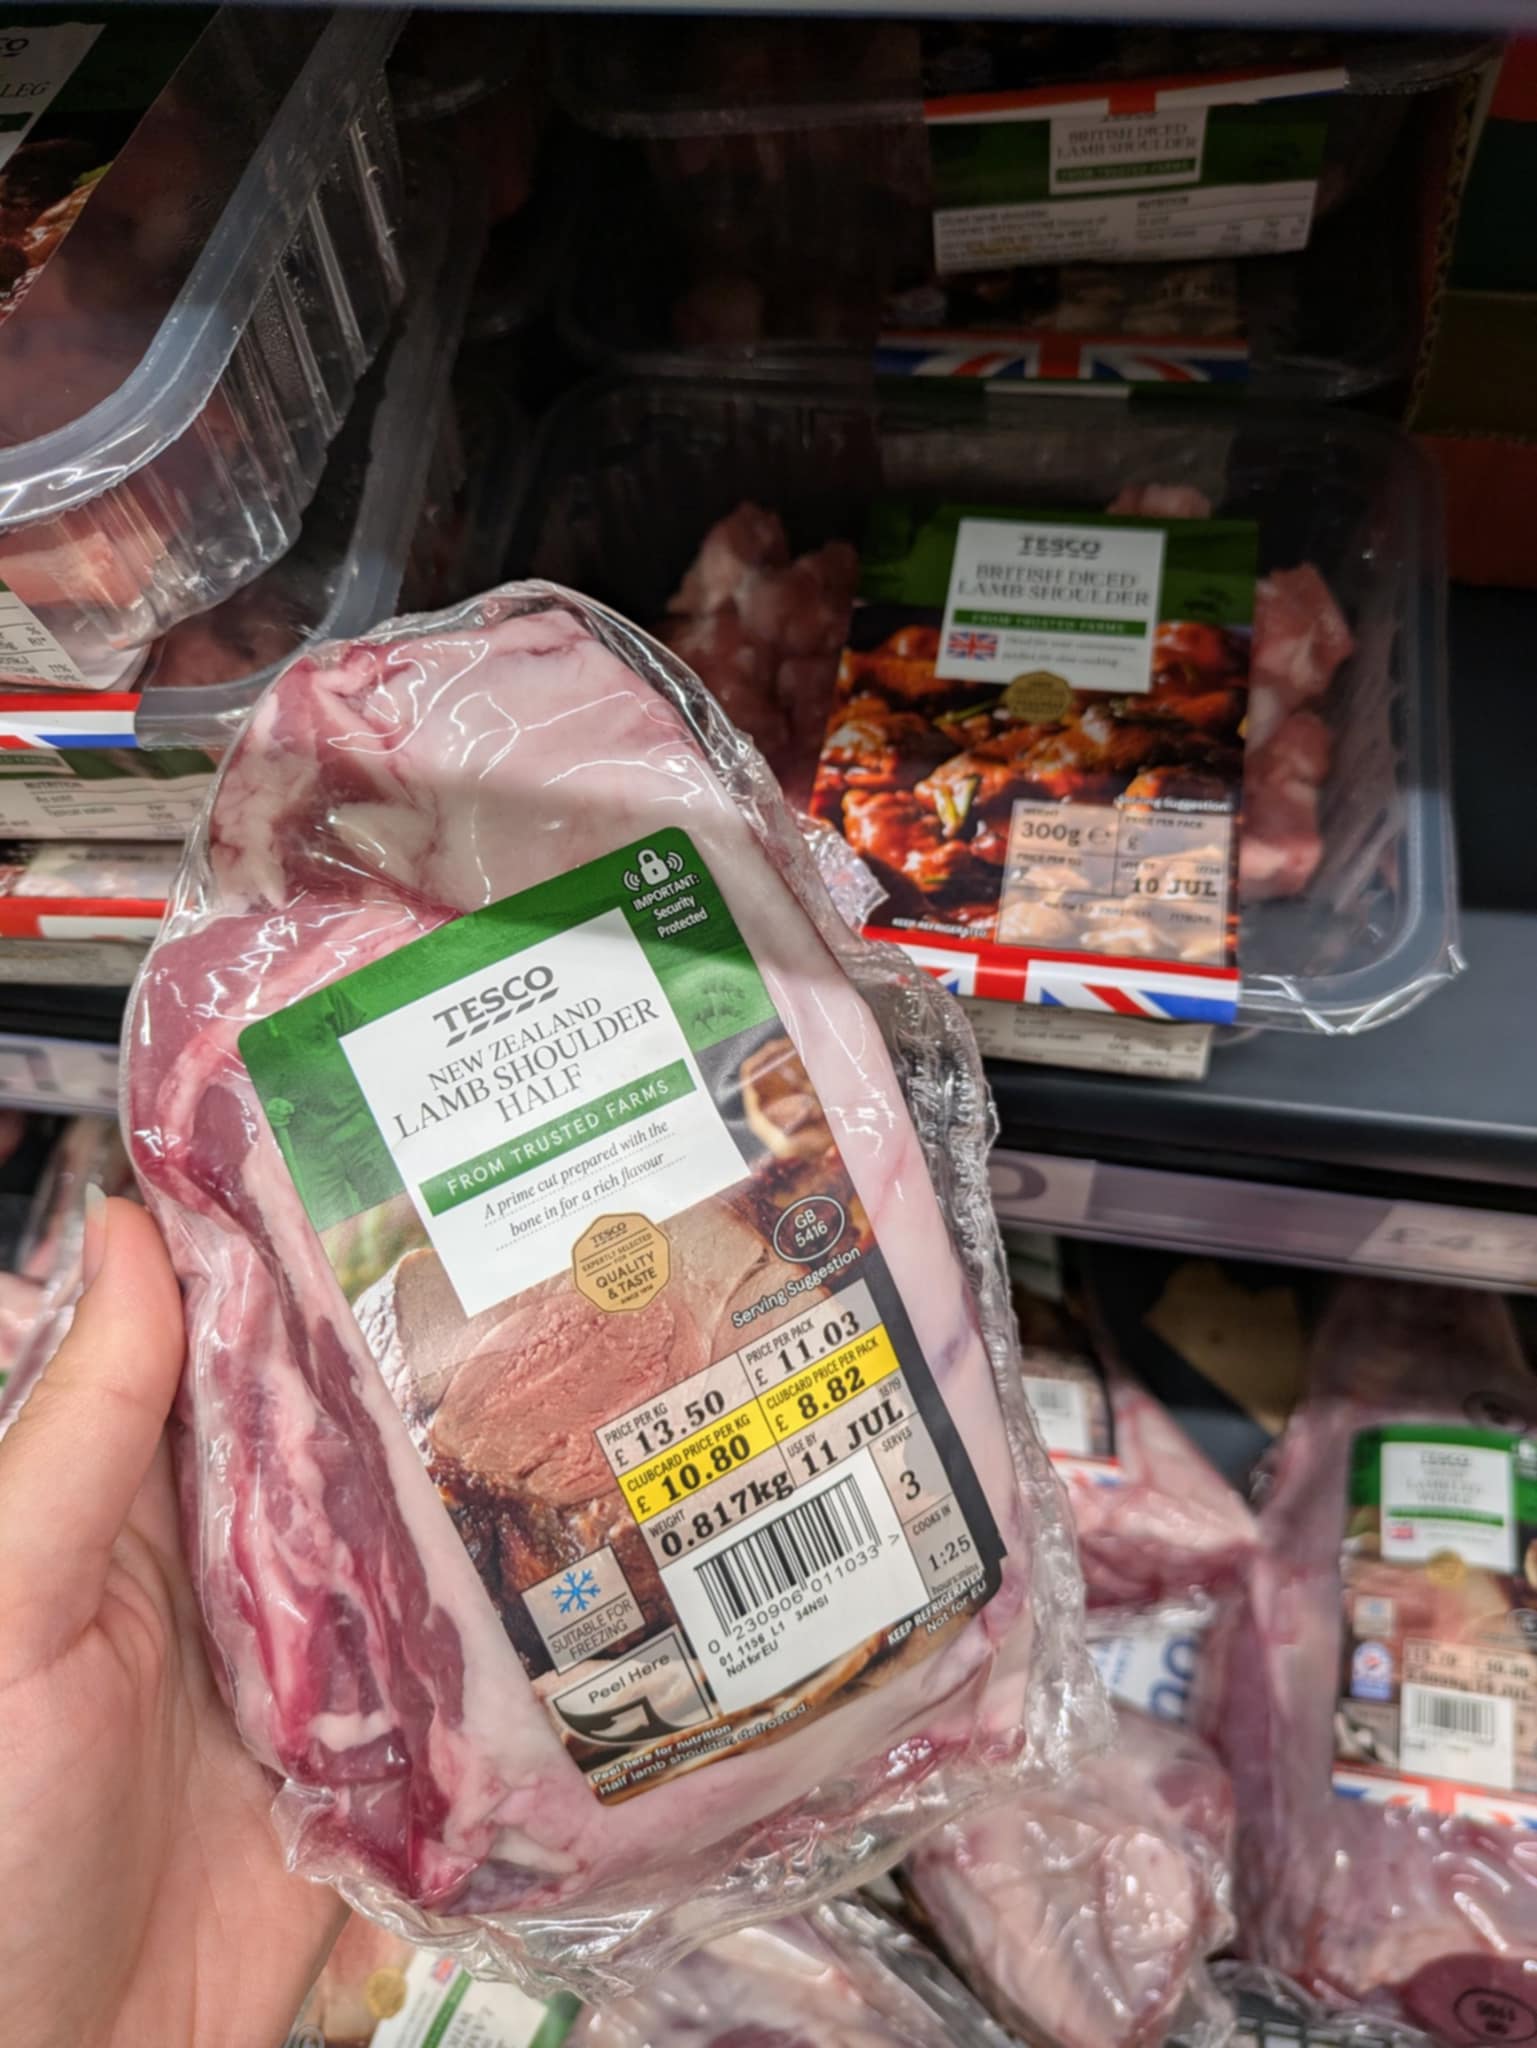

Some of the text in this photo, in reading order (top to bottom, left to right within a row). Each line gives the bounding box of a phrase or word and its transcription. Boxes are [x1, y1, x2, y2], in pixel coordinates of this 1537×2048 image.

[1018, 534, 1101, 559] TESCO
[958, 580, 1150, 607] LAMB SHOULDER
[976, 564, 1137, 589] BRITISH DICED
[1021, 821, 1081, 847] 300g
[653, 896, 695, 920] Security
[1133, 878, 1217, 897] 10 JUL
[657, 906, 708, 938] Protected
[432, 965, 557, 1042] TESCO
[427, 997, 602, 1091] NEW ZEALAND
[392, 997, 660, 1139] LAMB SHOULDER
[495, 1062, 583, 1123] HALF
[446, 1080, 669, 1198] FROM TRUSTED FARMS
[484, 1121, 668, 1220] A prime cut prepared with the
[509, 1152, 664, 1237] bone in for a rich flavour
[591, 1222, 627, 1246] TESCO
[794, 1208, 817, 1229] GB
[794, 1220, 828, 1248] 5416
[617, 1233, 652, 1254] SELECTED
[596, 1250, 655, 1288] QUALITY
[608, 1267, 657, 1300] & TASTE
[732, 1247, 861, 1328] Serving Suggestion
[746, 1318, 815, 1366] PRICE PER PACK
[754, 1310, 860, 1387] £ 11.03
[766, 1335, 880, 1411] CLUBCARD PRICE PER PACK
[774, 1413, 789, 1433] £
[797, 1365, 866, 1421] 8.82
[604, 1402, 669, 1445] PRICE PER KG
[614, 1390, 725, 1468] £ 13.50
[786, 1432, 818, 1458] USE BY
[801, 1400, 905, 1476] 11 JUL
[881, 1426, 913, 1453] SERVES
[626, 1413, 751, 1492] CLUBCARD PRICE PER KG
[636, 1434, 751, 1515] £ 10.80
[899, 1469, 921, 1501] 3
[648, 1509, 687, 1538] WEIGHT
[660, 1471, 796, 1557] 0.817kg
[912, 1503, 952, 1536] COOKS IN
[928, 1534, 972, 1572] 1:25
[551, 1598, 633, 1654] SUITABLE FOR
[926, 1580, 987, 1633] Not for EU
[569, 1617, 629, 1660] FREEZING
[887, 1619, 913, 1646] KEEP
[588, 1653, 671, 1704] Peel Here
[726, 1639, 779, 1678] Not for EU
[592, 1724, 732, 1784] Peel here for nutrition
[599, 1777, 628, 1796] Half
[630, 1759, 666, 1782] lamb
